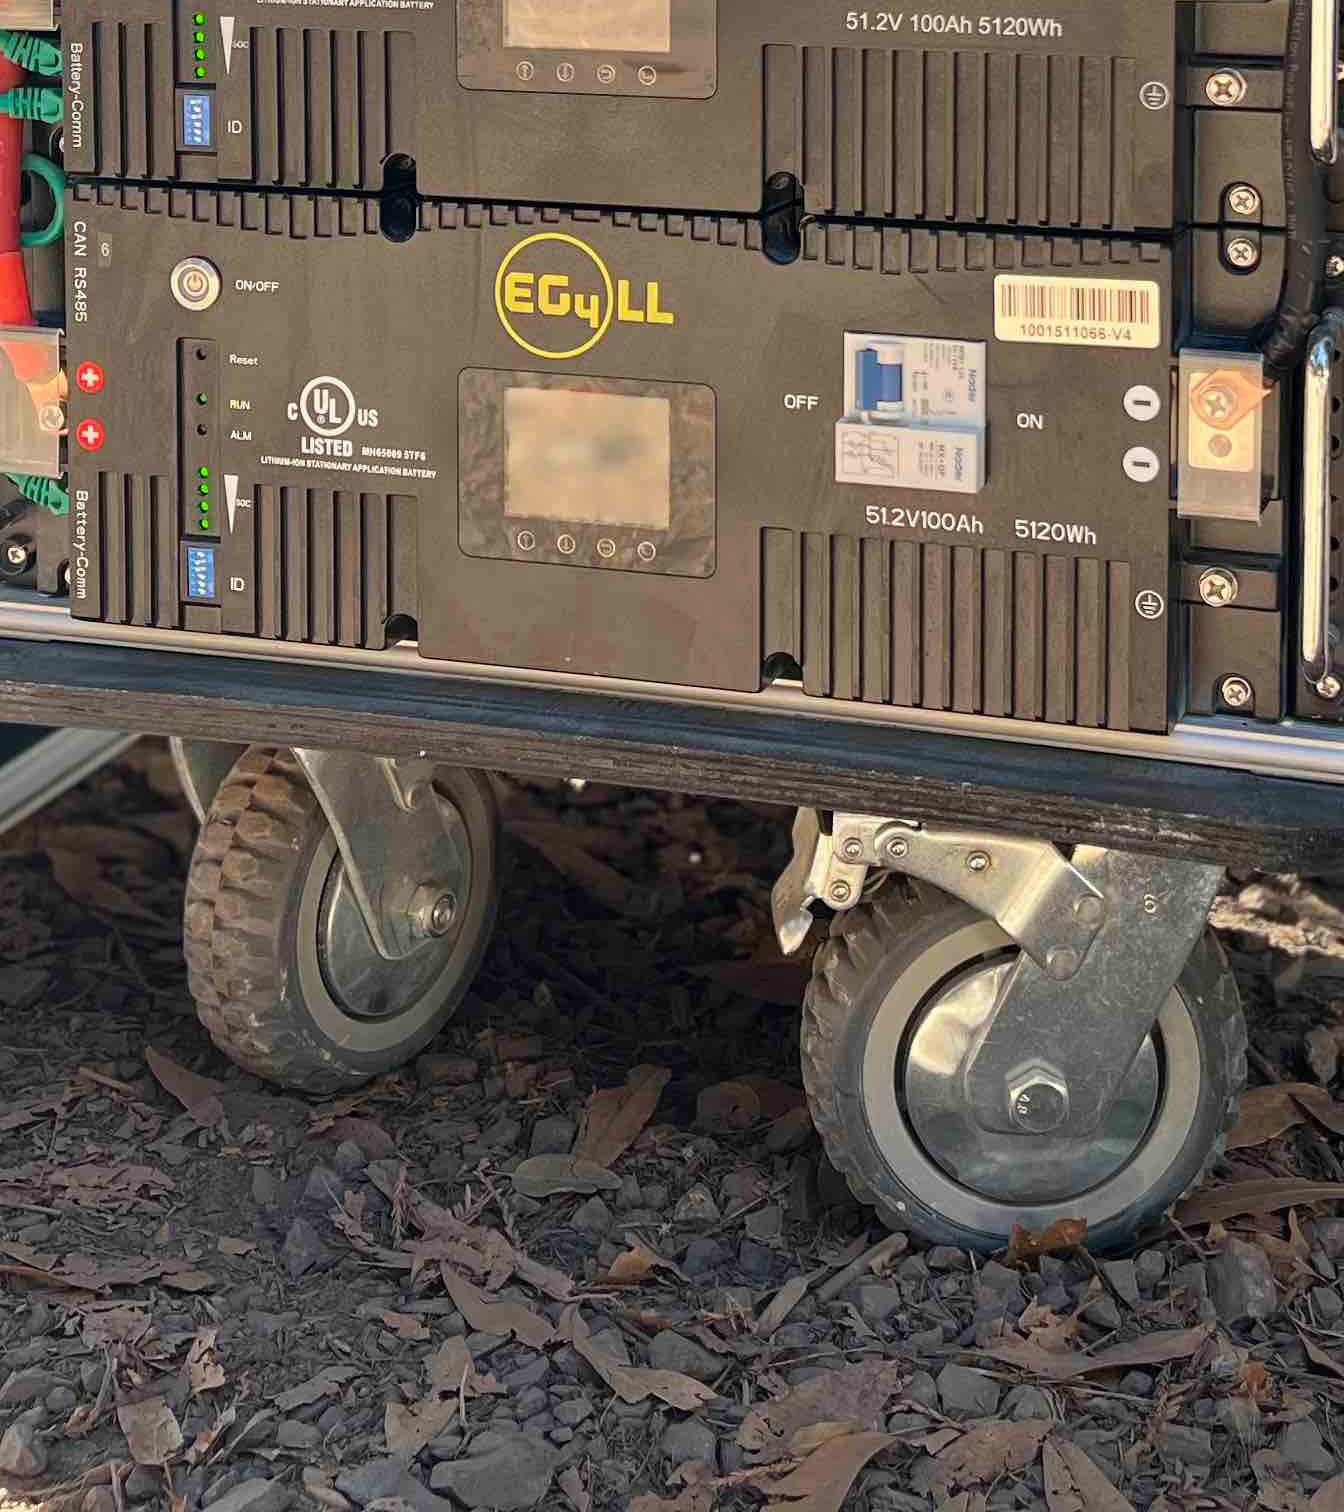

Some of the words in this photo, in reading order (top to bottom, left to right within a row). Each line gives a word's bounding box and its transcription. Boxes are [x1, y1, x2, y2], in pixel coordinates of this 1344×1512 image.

[349, 0, 399, 9] APPLICATION
[399, 1, 434, 10] BATTERY
[845, 11, 903, 31] 51.2V
[910, 14, 972, 34] 100Ah
[978, 16, 1063, 37] 5120Wh
[68, 42, 84, 148] Battery-Comm
[227, 120, 243, 134] ID
[73, 220, 88, 257] CAN
[100, 242, 110, 256] 6
[74, 267, 88, 322] RS485
[235, 279, 280, 293] ON/OFF
[617, 279, 674, 324] LL
[229, 354, 259, 366] Reset
[229, 399, 251, 410] RUN
[784, 393, 819, 410] OFF
[357, 408, 379, 427] US
[1016, 412, 1044, 430] ON
[230, 430, 252, 441] ALM
[301, 436, 353, 457] LISTED
[260, 455, 306, 468] LITHIUM-ION
[306, 460, 352, 472] STATIONARY
[352, 463, 402, 476] APPLICATION
[402, 467, 437, 479] BATTERY
[1015, 519, 1097, 545] 5120Wh
[73, 490, 89, 599] Battery-Comm
[230, 577, 245, 591] ID
